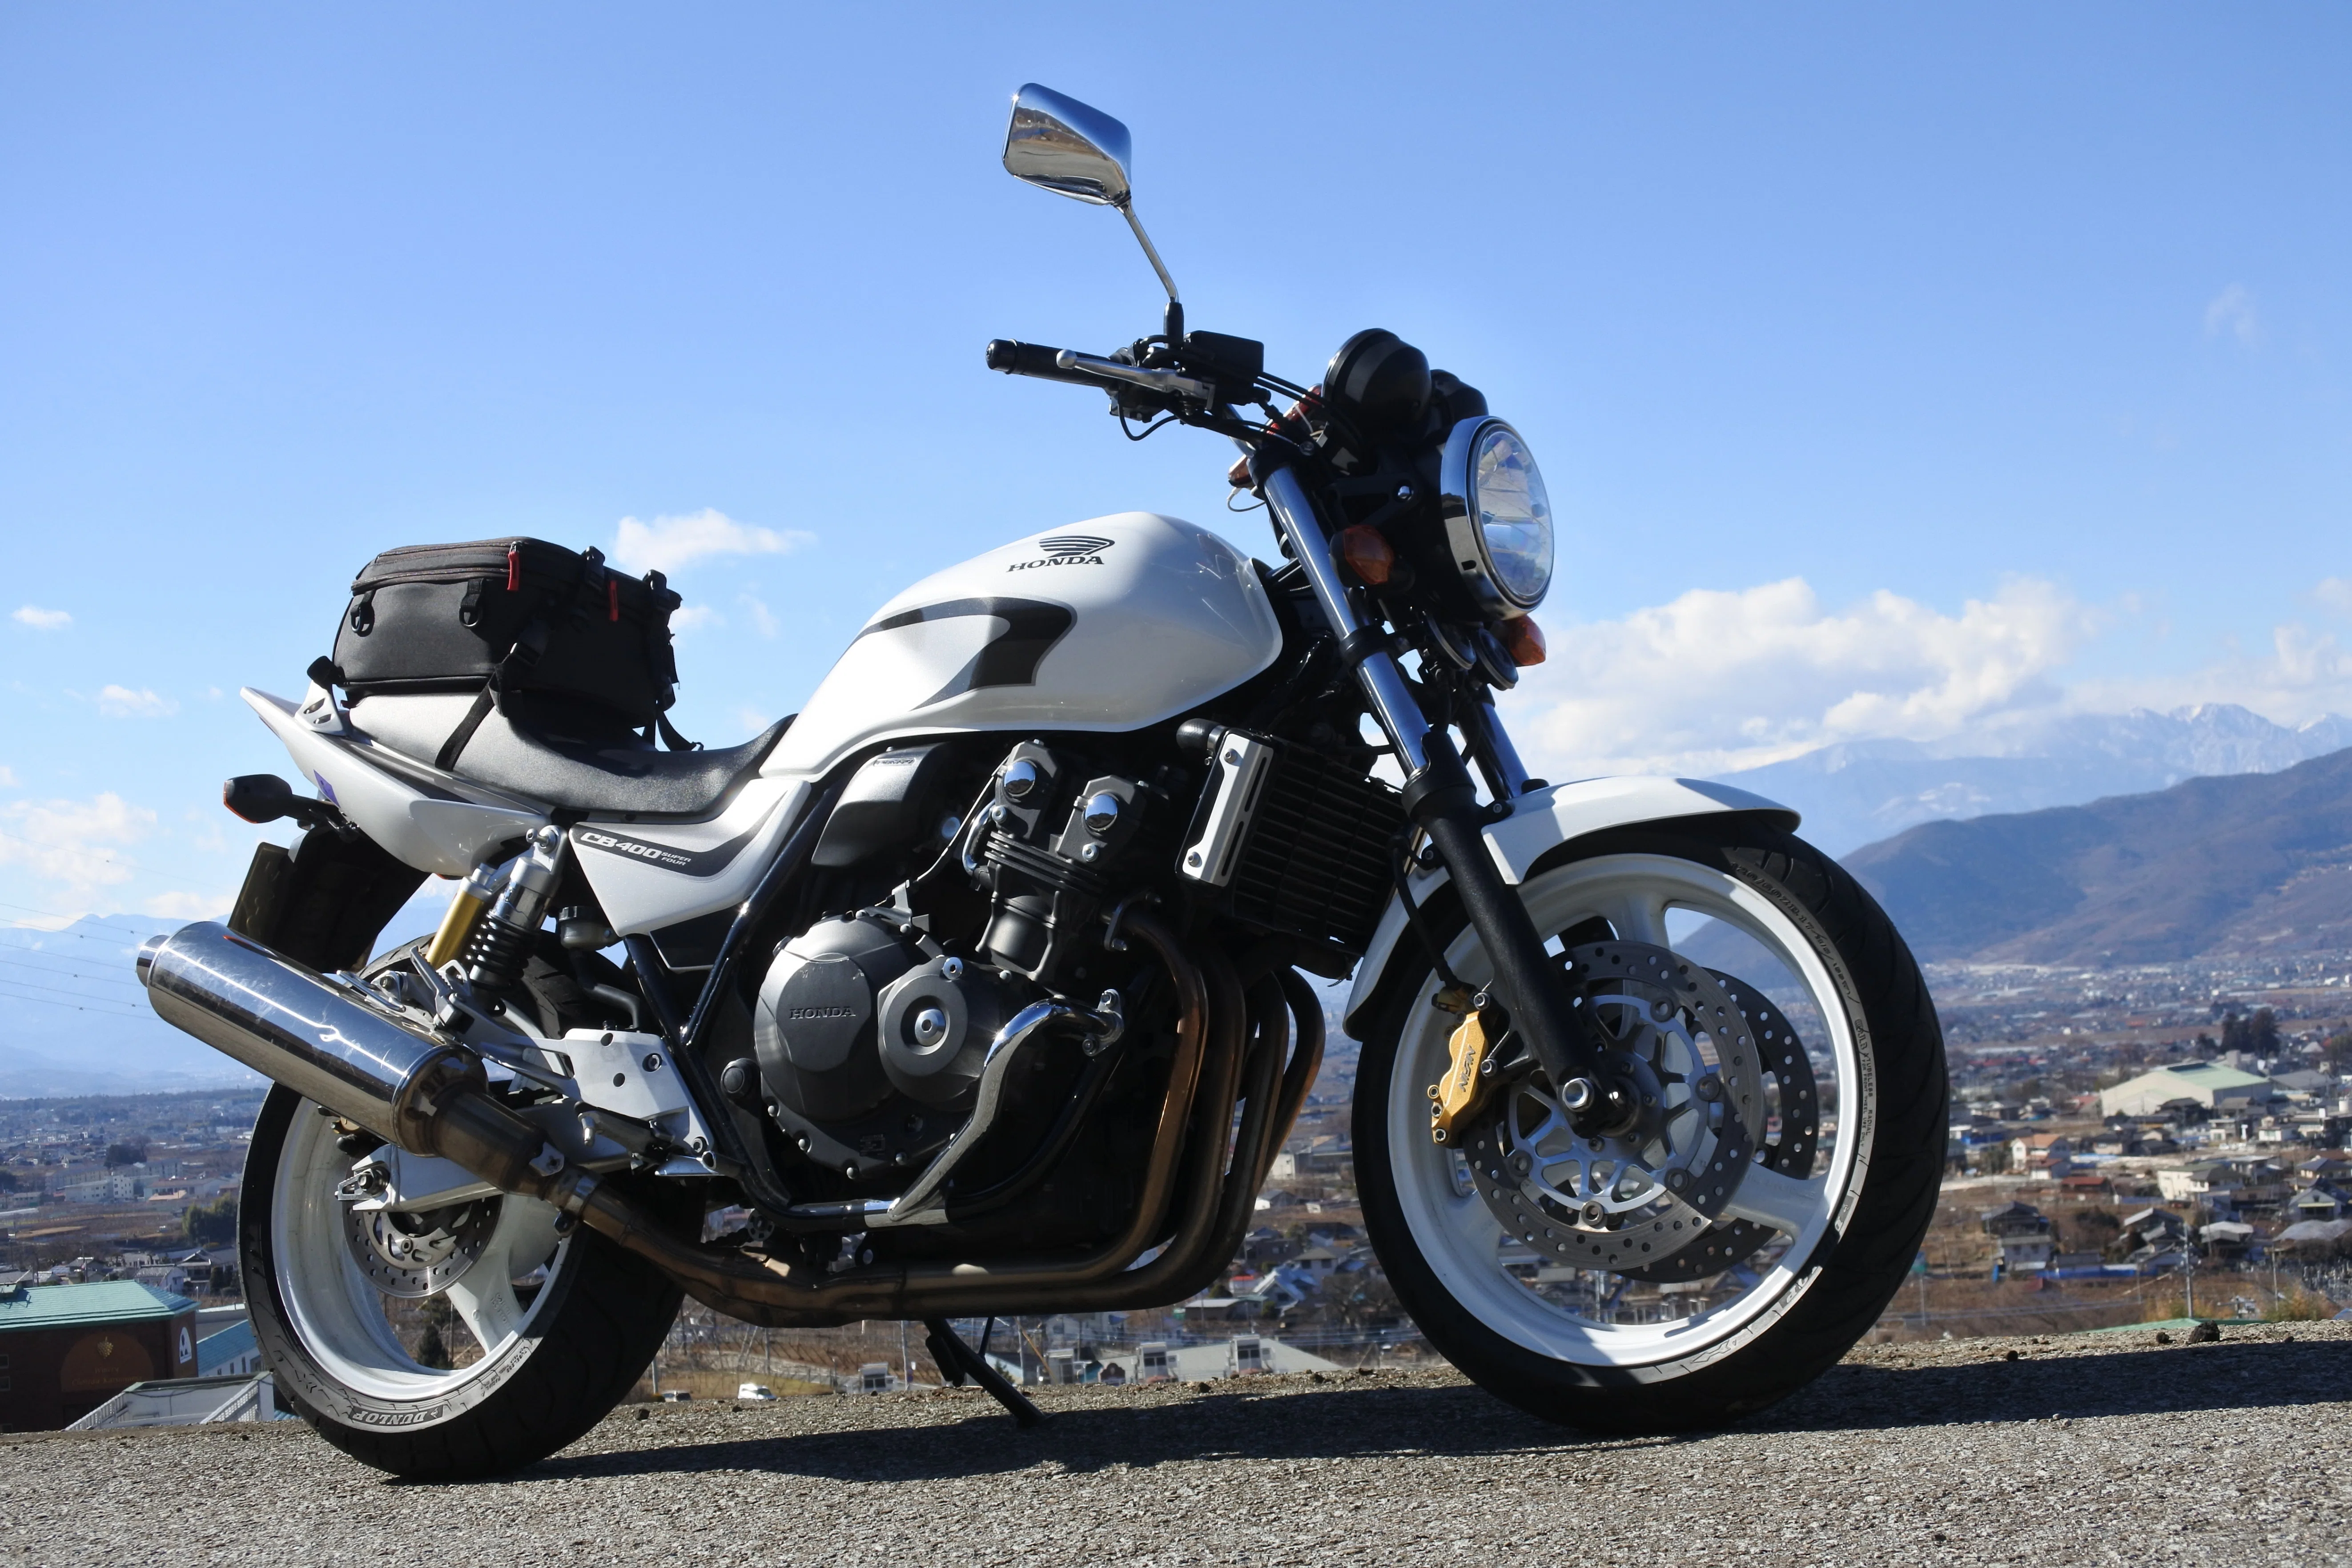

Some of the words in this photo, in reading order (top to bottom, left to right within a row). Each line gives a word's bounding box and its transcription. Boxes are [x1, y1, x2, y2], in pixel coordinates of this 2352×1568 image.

[1005, 556, 1105, 572] HONDA
[580, 832, 662, 859] CB400
[661, 852, 692, 863] SUPER
[661, 856, 687, 866] FOUR
[789, 1006, 856, 1020] HONDA
[1865, 1109, 1873, 1136] RADIAL
[506, 1348, 527, 1373] TUBELESS
[352, 1411, 427, 1425] DUNLOP
